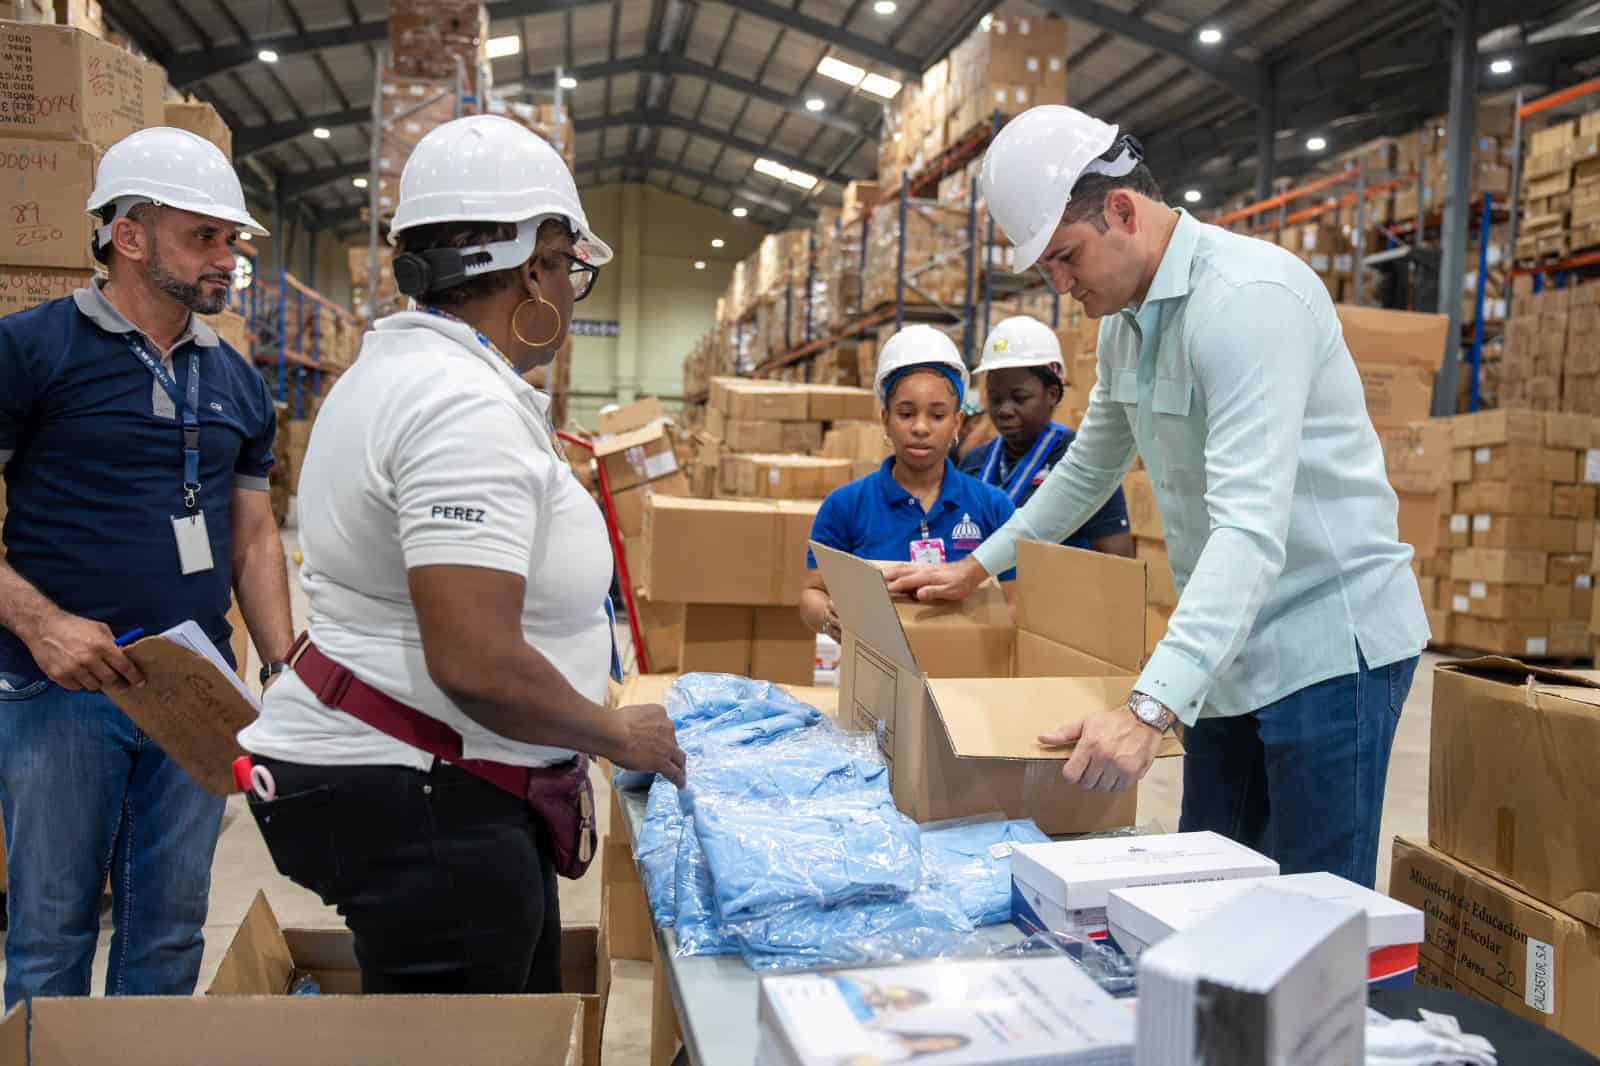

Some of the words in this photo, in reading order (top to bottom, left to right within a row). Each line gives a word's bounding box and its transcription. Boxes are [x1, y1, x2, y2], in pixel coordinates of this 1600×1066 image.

[431, 505, 486, 523] PEREZ
[1408, 867, 1457, 905] Ministerio
[1457, 897, 1470, 912] de
[1472, 902, 1529, 945] Educación
[1463, 921, 1504, 956] Escolar
